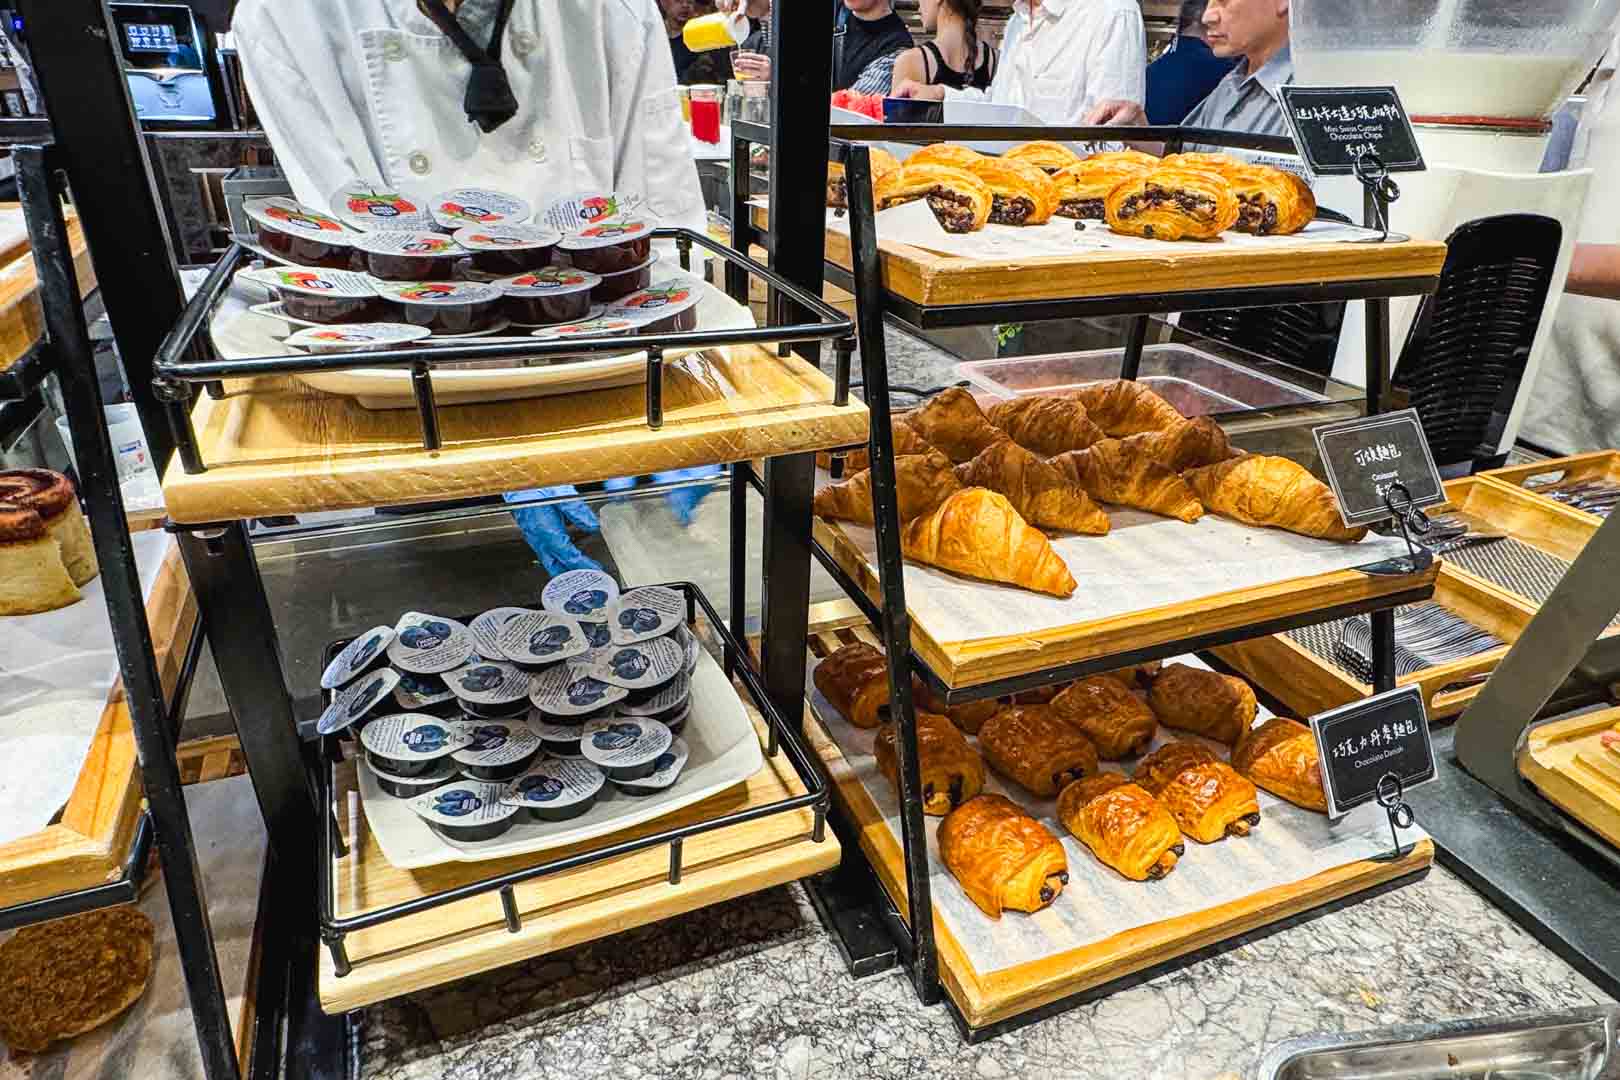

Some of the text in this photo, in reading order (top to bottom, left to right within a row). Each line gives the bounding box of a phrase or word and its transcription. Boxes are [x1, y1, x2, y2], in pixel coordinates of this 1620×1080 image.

[1332, 719, 1418, 758] 巧克力丹麥麵包
[1354, 752, 1384, 769] Chocolate
